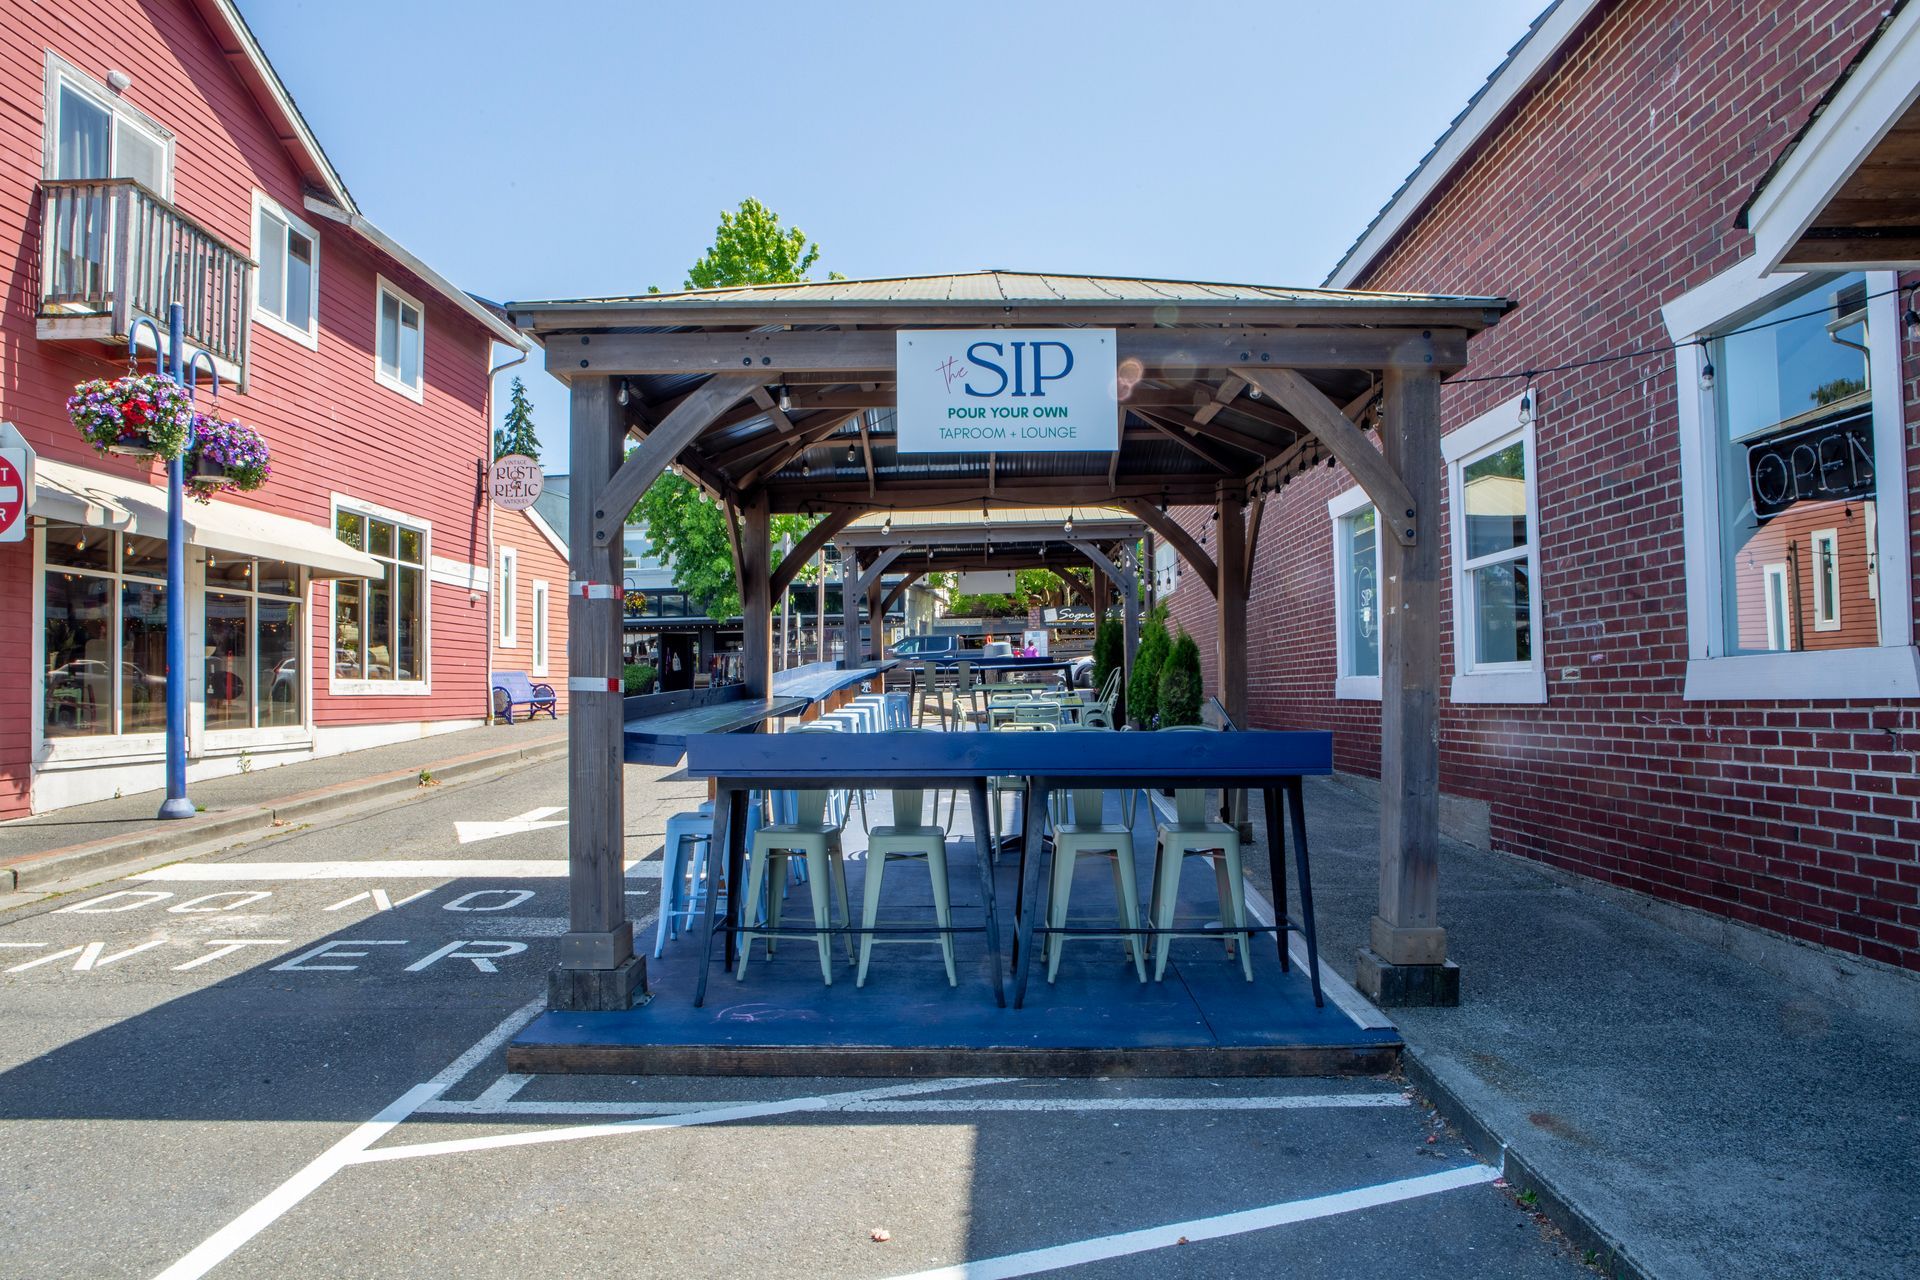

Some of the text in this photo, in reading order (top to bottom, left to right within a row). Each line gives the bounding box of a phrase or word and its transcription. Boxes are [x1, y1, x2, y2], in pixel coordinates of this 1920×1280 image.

[935, 341, 1075, 398] the SIP
[948, 406, 1068, 419] POUR YOUR OWN
[938, 427, 1006, 439] TAPROOM
[1021, 426, 1078, 439] LOUNGE
[496, 465, 537, 480] RUST
[1756, 431, 1875, 505] OPEN
[494, 484, 538, 497] RELIC
[51, 890, 273, 914] DO
[0, 940, 529, 973] NTER
